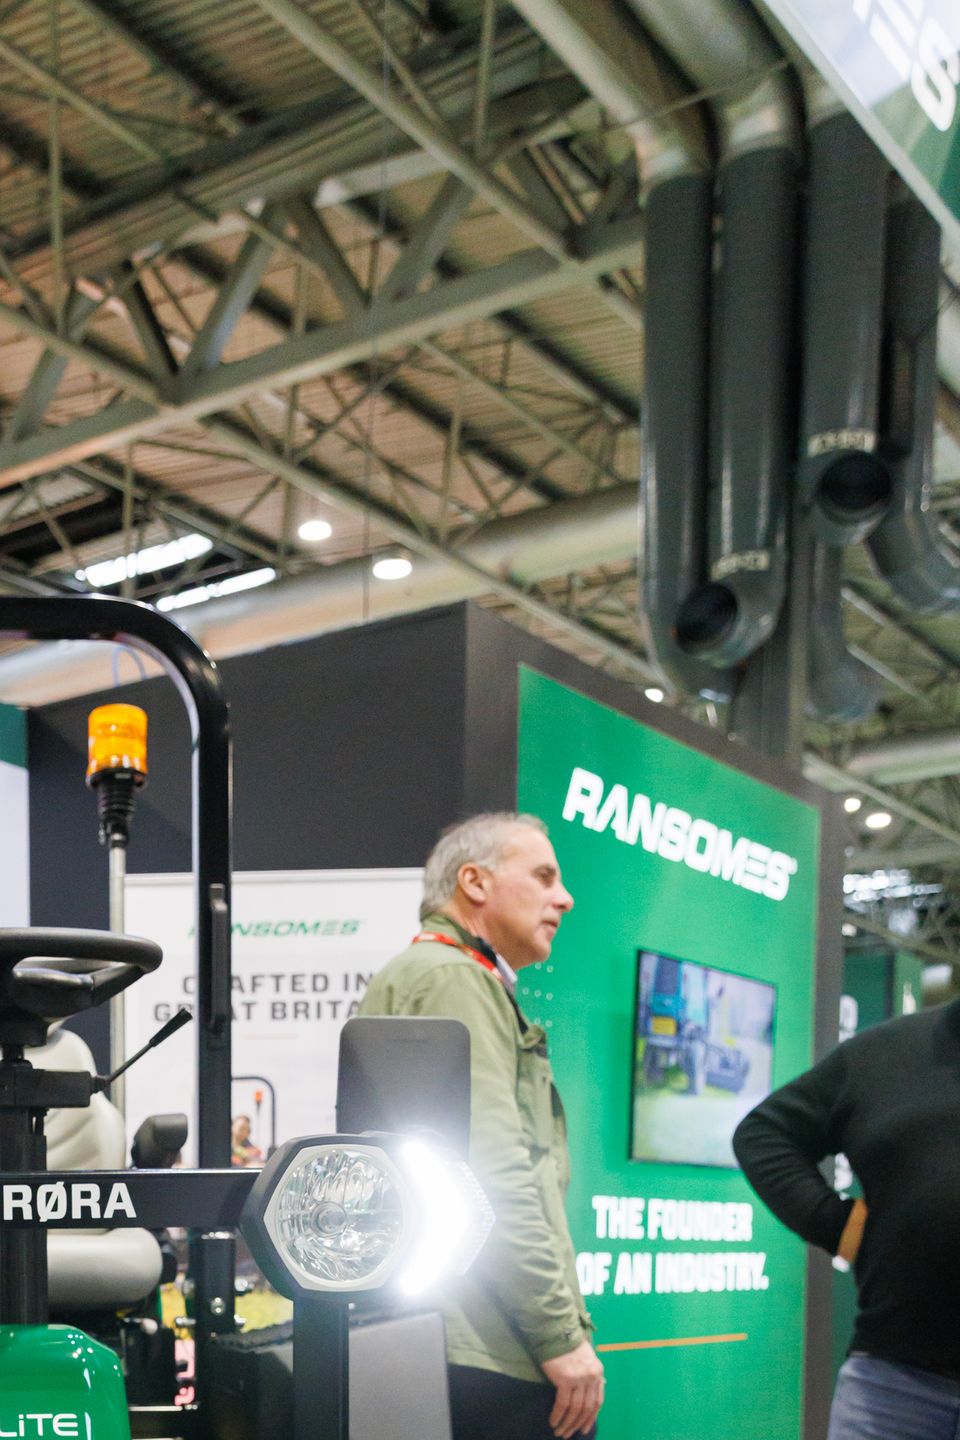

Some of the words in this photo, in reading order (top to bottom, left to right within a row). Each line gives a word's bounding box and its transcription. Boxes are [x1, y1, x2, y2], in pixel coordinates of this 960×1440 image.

[562, 767, 793, 901] RANSOMES
[189, 919, 360, 937] NSOMES
[183, 973, 329, 994] CAFTED
[592, 1195, 645, 1239] THE
[647, 1198, 753, 1241] FOUNDER
[576, 1252, 612, 1295] OF
[613, 1252, 652, 1295] AN
[655, 1252, 769, 1293] INDUSTRY.
